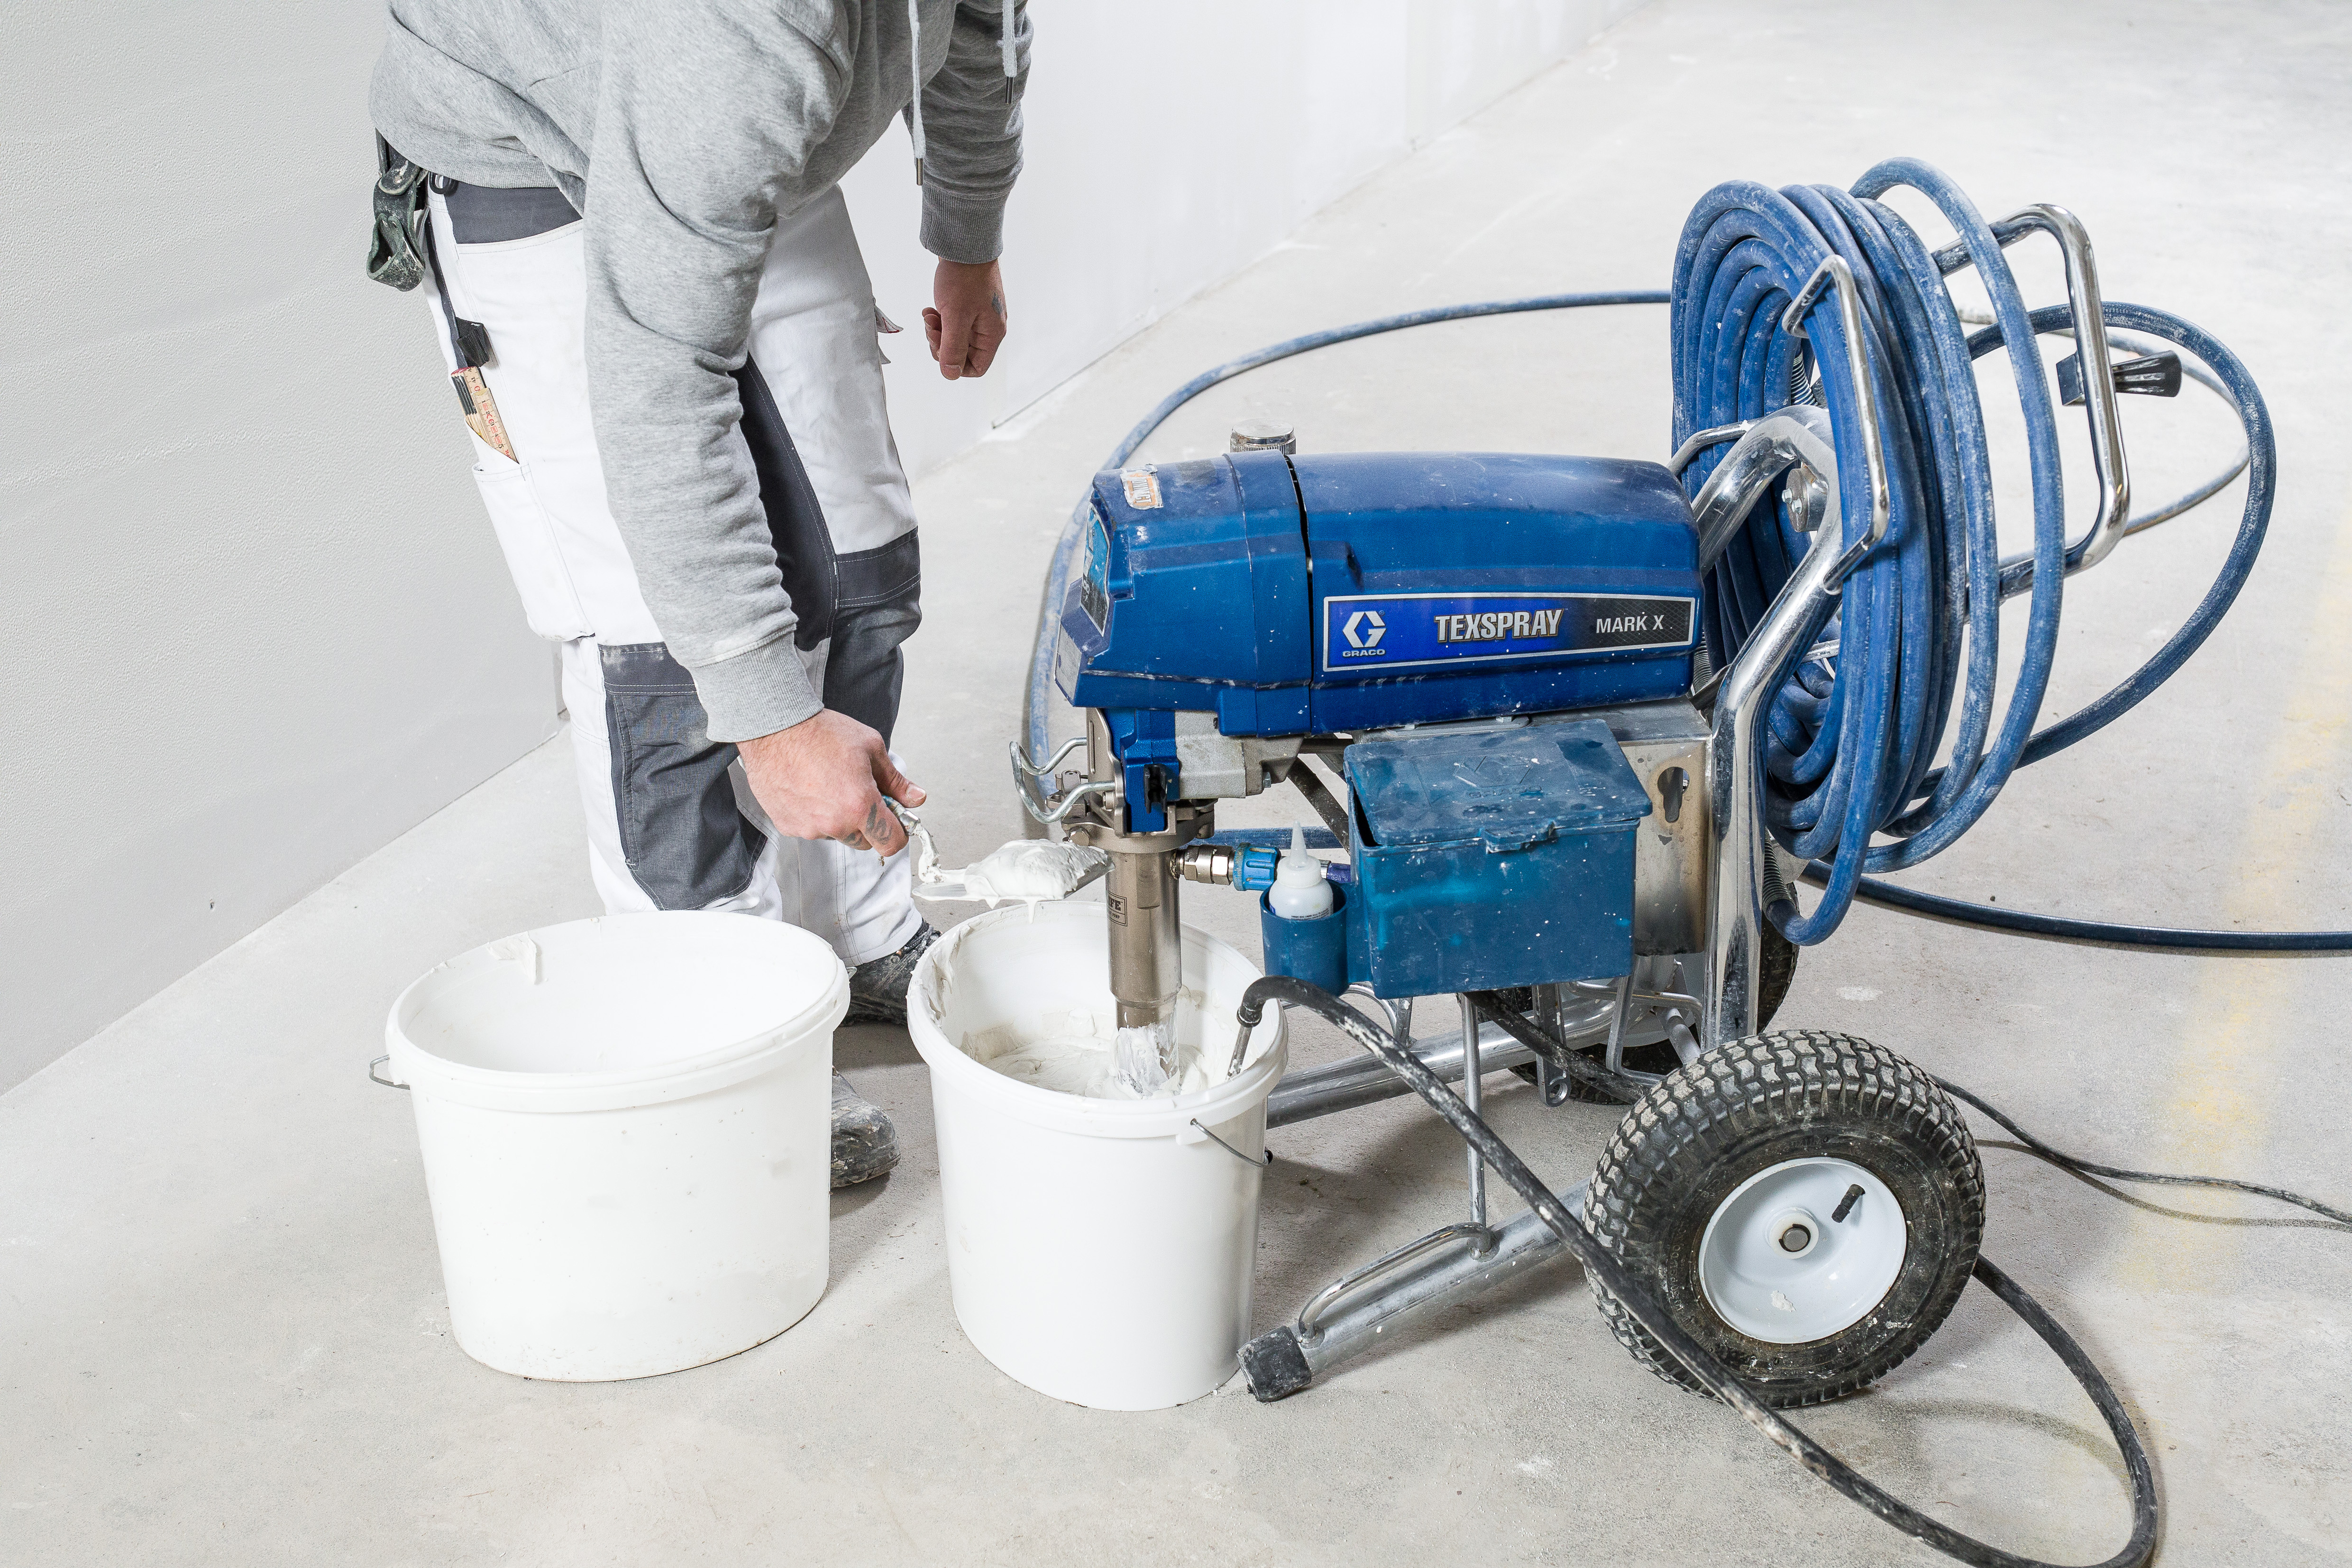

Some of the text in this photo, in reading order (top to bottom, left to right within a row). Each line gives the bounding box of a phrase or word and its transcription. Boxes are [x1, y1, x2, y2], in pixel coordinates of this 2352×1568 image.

[1435, 609, 1665, 642] TEXSPRAY MARK X
[1342, 649, 1385, 657] GRACO
